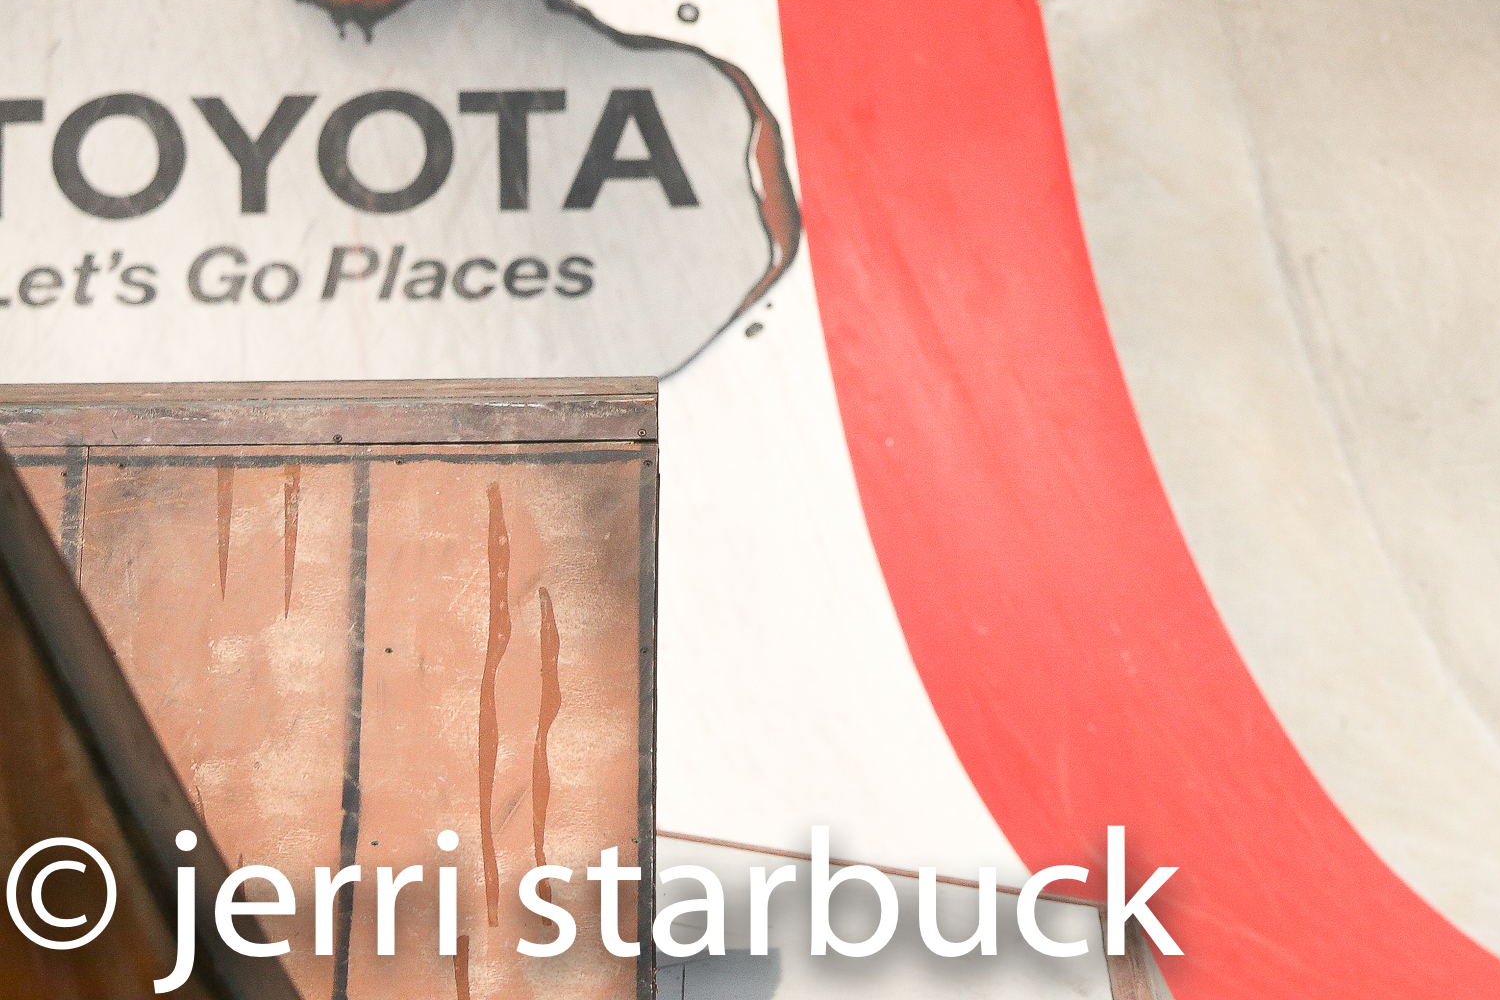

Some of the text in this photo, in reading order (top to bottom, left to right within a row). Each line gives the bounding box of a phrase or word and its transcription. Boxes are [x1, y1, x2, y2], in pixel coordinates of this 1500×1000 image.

[0, 244, 596, 306] et's Go Places
